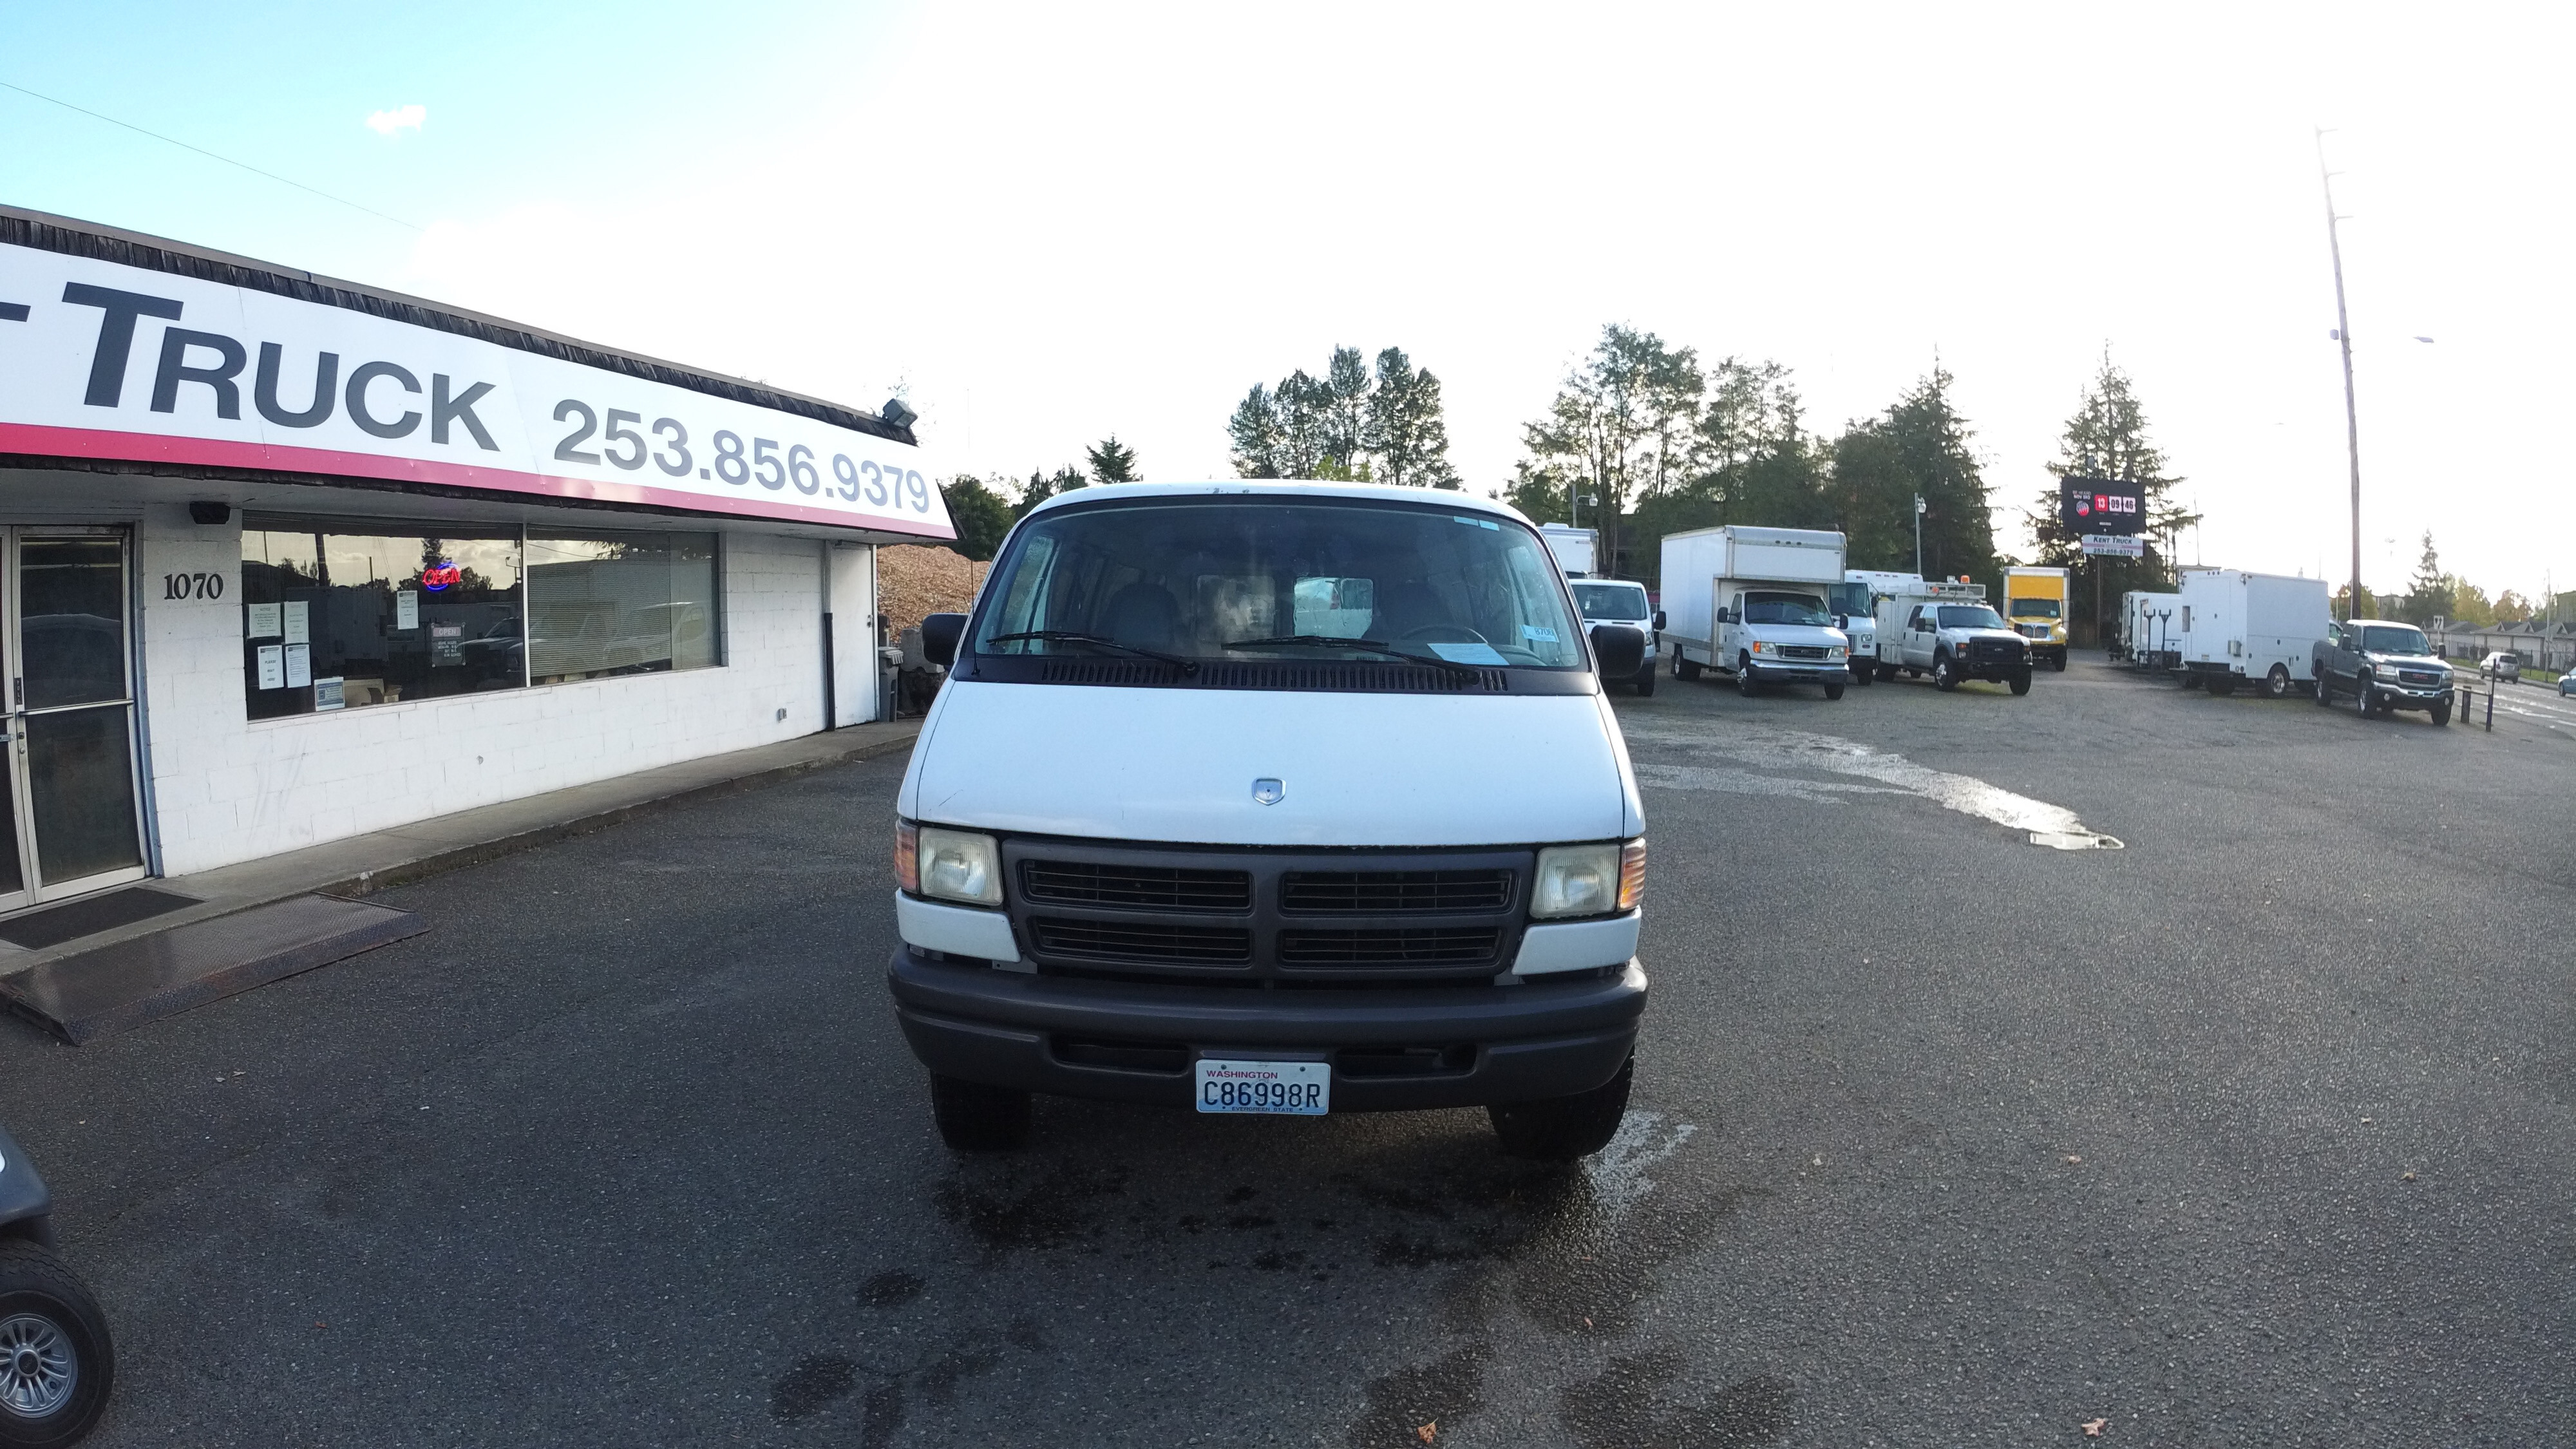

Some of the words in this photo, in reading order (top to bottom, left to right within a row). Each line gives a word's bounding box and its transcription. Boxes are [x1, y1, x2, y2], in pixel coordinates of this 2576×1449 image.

[62, 281, 500, 452] TRUCK
[553, 399, 931, 514] 253.856.9379
[2111, 499, 2119, 509] 09
[2125, 500, 2134, 510] 46
[2112, 536, 2132, 545] TRUCK
[422, 567, 461, 586] OPEN
[164, 573, 223, 600] 1070
[1206, 1070, 1278, 1079] WASHINGTON
[1204, 1081, 1321, 1108] C86998R
